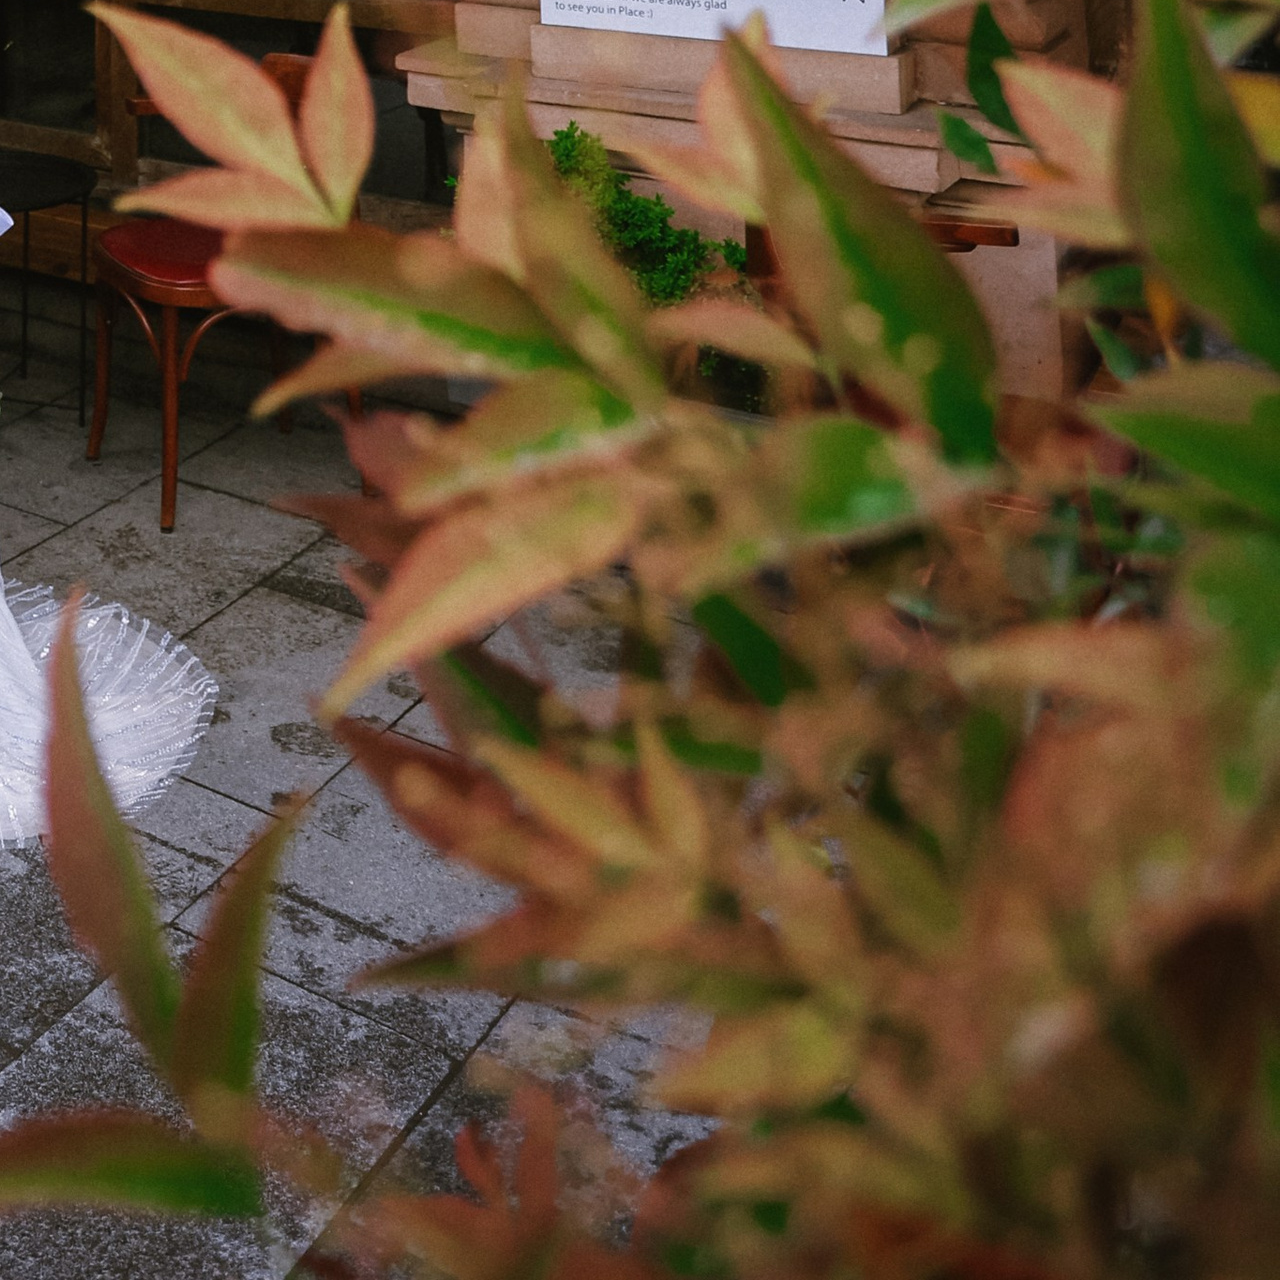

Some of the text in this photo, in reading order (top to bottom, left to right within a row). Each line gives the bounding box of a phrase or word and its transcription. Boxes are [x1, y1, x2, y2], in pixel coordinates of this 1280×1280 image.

[555, 1, 566, 11] to
[567, 3, 584, 13] see
[586, 5, 605, 16] you
[606, 5, 617, 15] in
[618, 6, 646, 18] Place
[704, 0, 728, 12] glad
